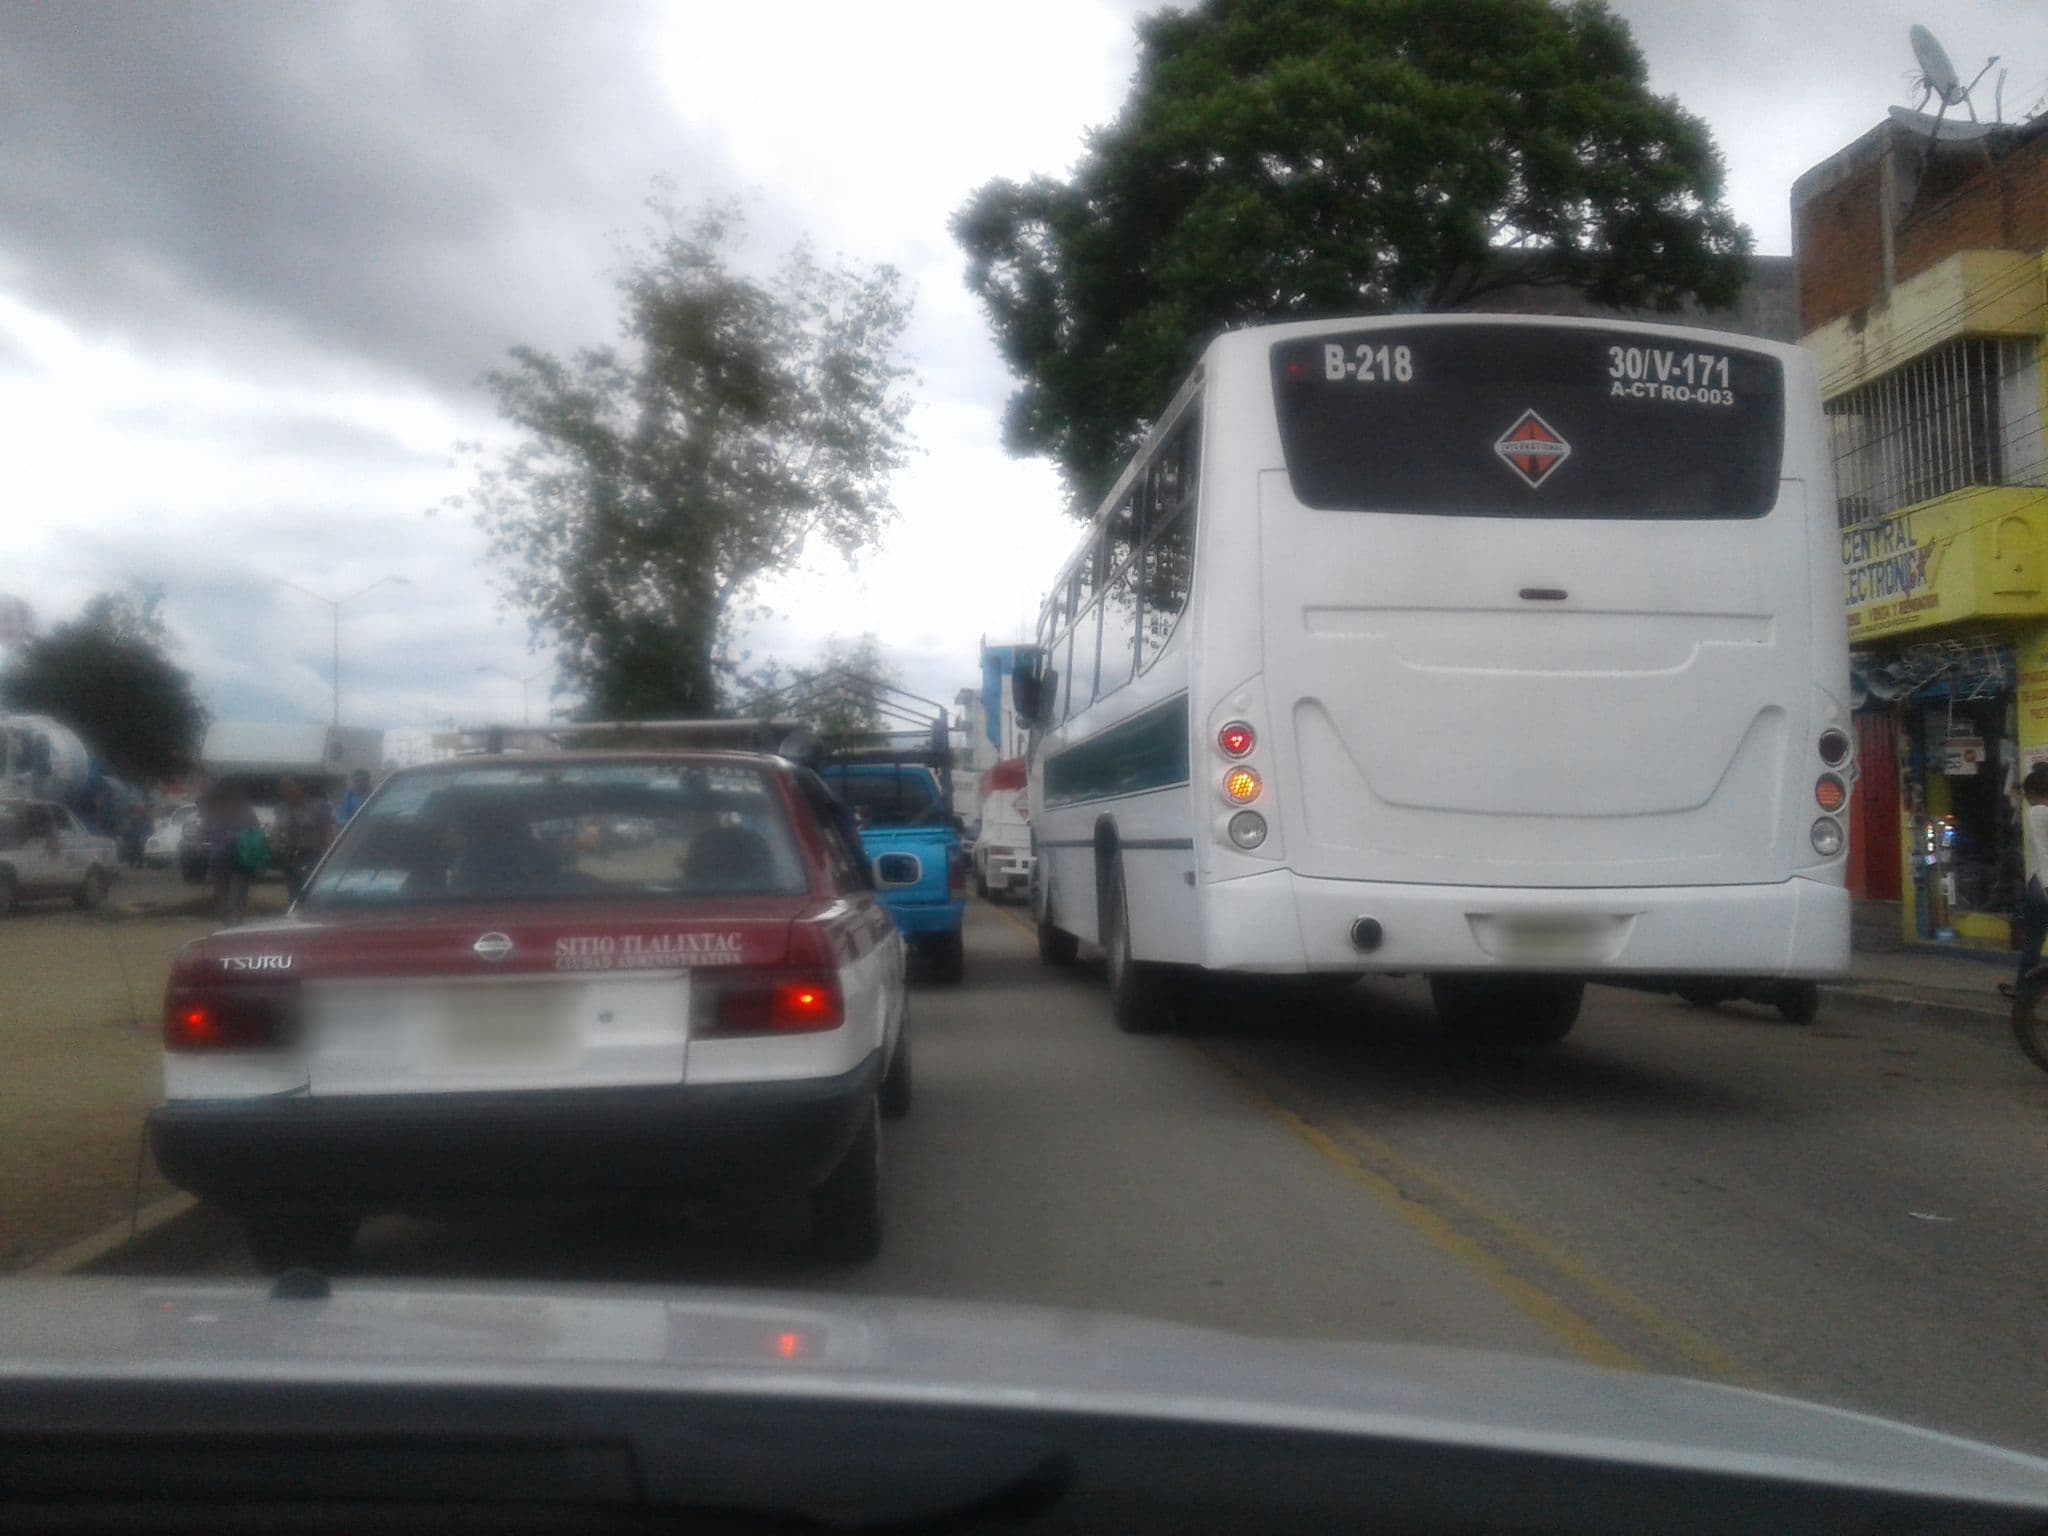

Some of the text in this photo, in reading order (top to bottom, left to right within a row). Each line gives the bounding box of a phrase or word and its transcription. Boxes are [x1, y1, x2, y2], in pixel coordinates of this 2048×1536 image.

[1324, 343, 1413, 382] B-218
[1608, 345, 1730, 389] 30/V-171
[1841, 514, 1918, 565] CENTRAL
[218, 953, 293, 971] TSURU
[555, 931, 743, 956] SITIO TLALIXTAC
